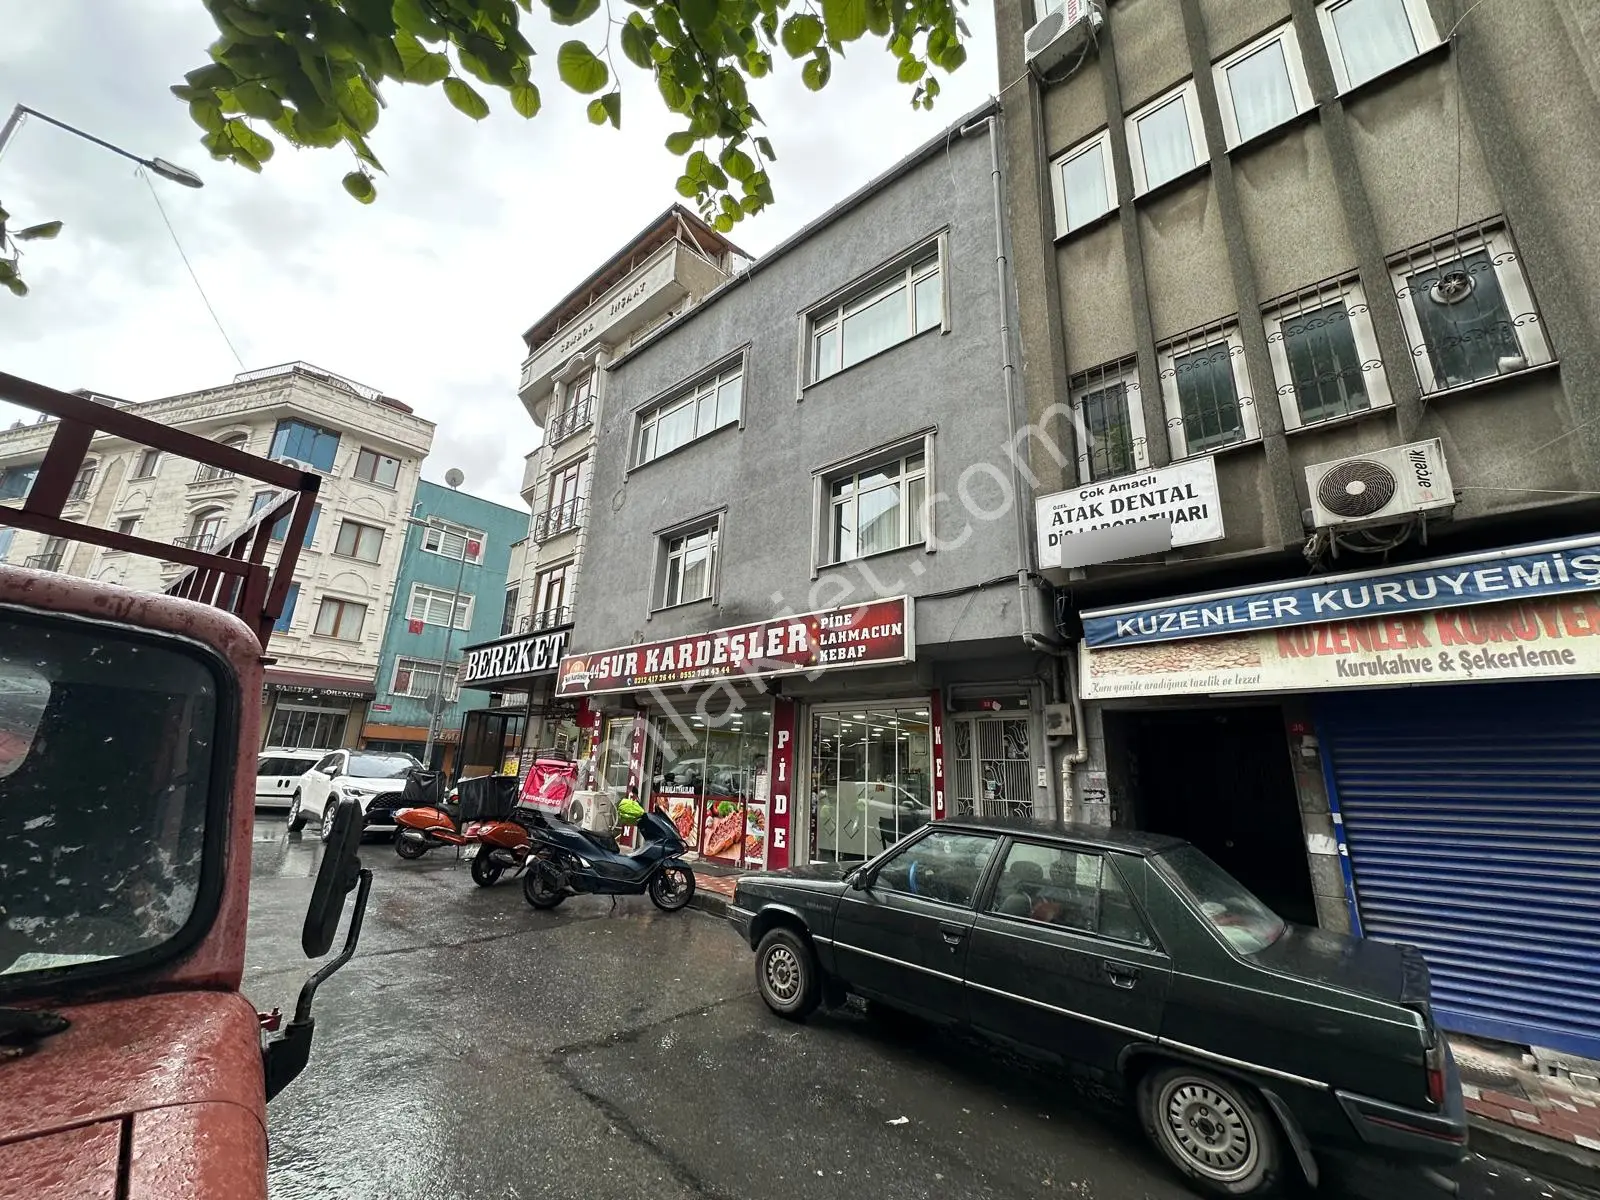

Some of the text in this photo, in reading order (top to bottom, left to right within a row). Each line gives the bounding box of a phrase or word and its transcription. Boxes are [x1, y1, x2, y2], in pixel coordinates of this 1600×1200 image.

[1080, 476, 1157, 501] Çok Amaçlı
[1409, 450, 1432, 488] arçelik
[1052, 502, 1104, 526] ATAK
[1111, 483, 1198, 514] DENTAL
[1116, 552, 1600, 638] KUZENLER KURUYEMİŞ
[820, 614, 852, 630] PİDE
[820, 623, 902, 645] LAHMACUN
[1276, 598, 1600, 659] KUZENLER KURUYE
[464, 632, 566, 680] BEREKET
[590, 623, 808, 679] 44 SUR KARDEŞLER
[820, 645, 866, 662] KEBAP
[1336, 645, 1576, 678] Kurukahve & Şekerleme
[668, 673, 676, 681] 44
[721, 666, 730, 674] 44
[1190, 674, 1220, 688] tazelik
[1222, 677, 1232, 686] ve
[1235, 672, 1260, 685] lezzet
[622, 711, 641, 837] LAHMACN
[934, 726, 944, 811] KEB
[773, 730, 790, 848] PİDE
